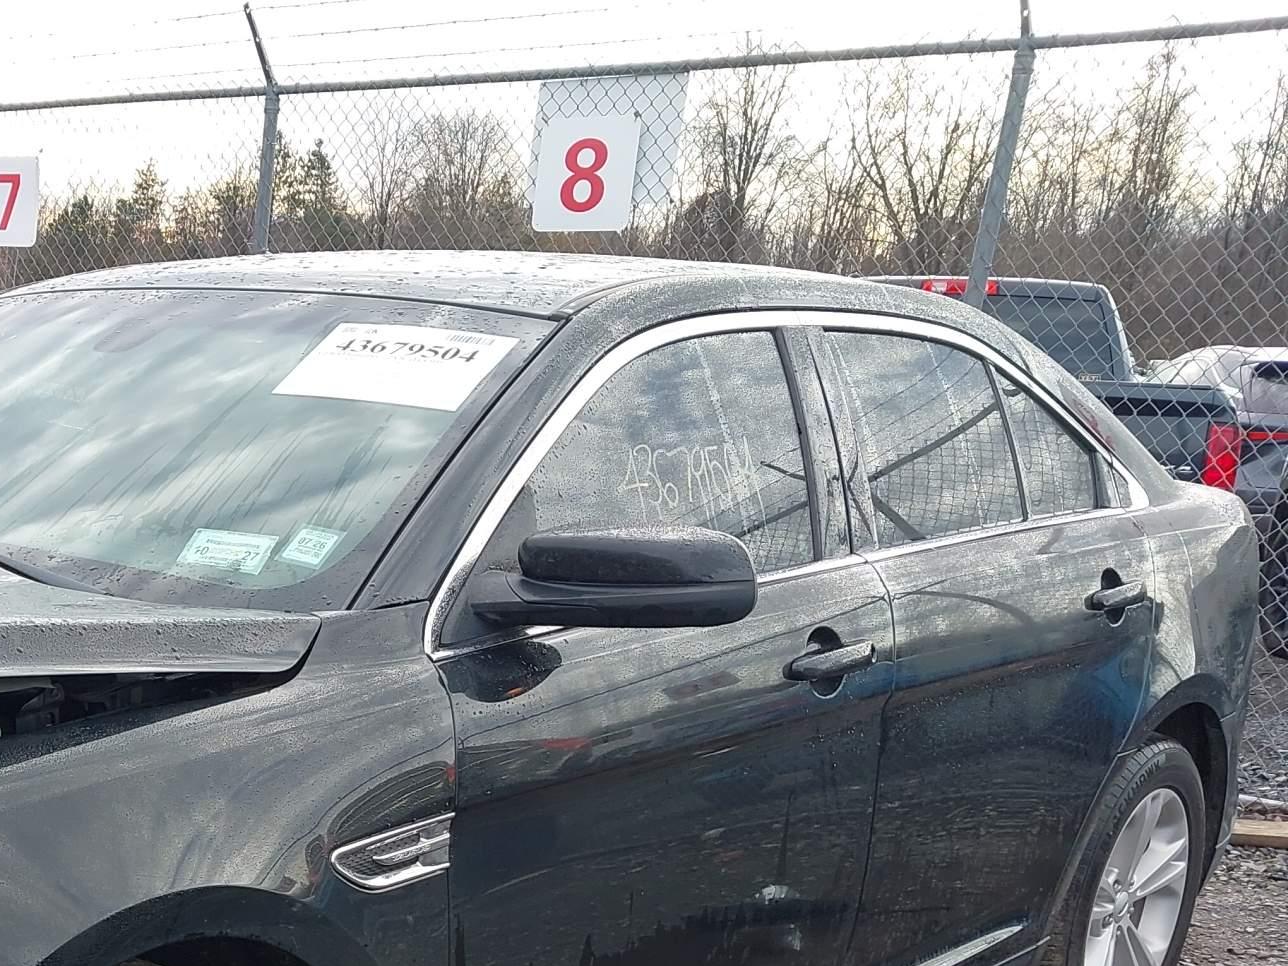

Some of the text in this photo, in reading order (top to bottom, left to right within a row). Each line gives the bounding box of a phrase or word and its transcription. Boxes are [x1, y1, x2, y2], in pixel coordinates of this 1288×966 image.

[560, 138, 608, 212] 8
[336, 339, 480, 363] 43679504
[242, 551, 260, 561] 27
